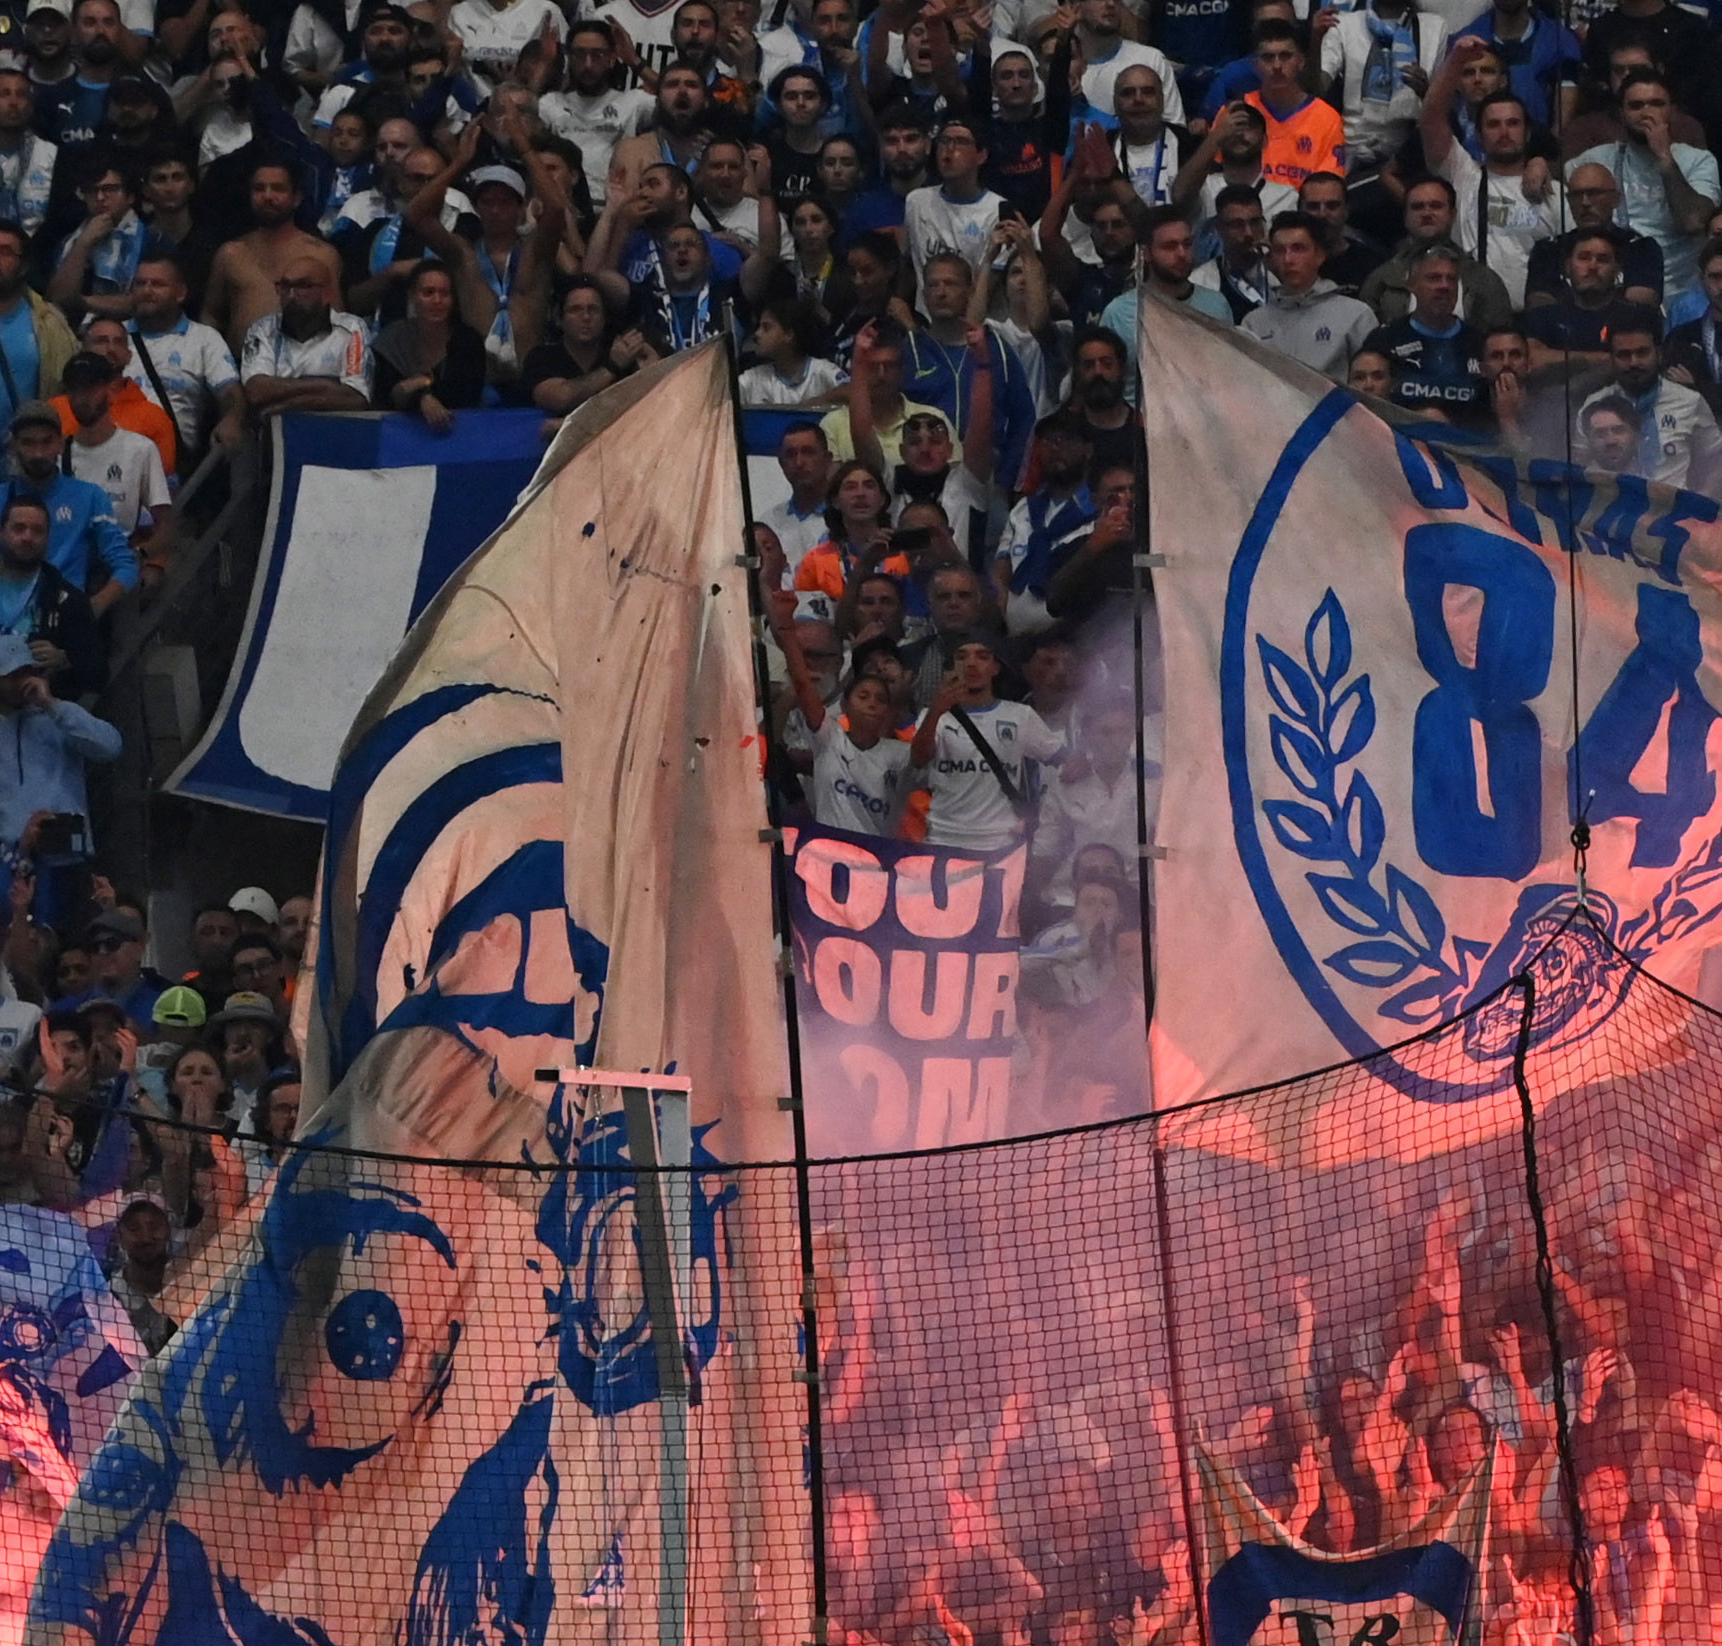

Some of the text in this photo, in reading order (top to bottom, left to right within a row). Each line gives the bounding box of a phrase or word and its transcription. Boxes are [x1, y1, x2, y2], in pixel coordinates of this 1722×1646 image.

[1401, 382, 1441, 398] CMA
[937, 759, 977, 774] CMA
[782, 827, 1028, 940] OUT
[804, 935, 1021, 1041] OUR
